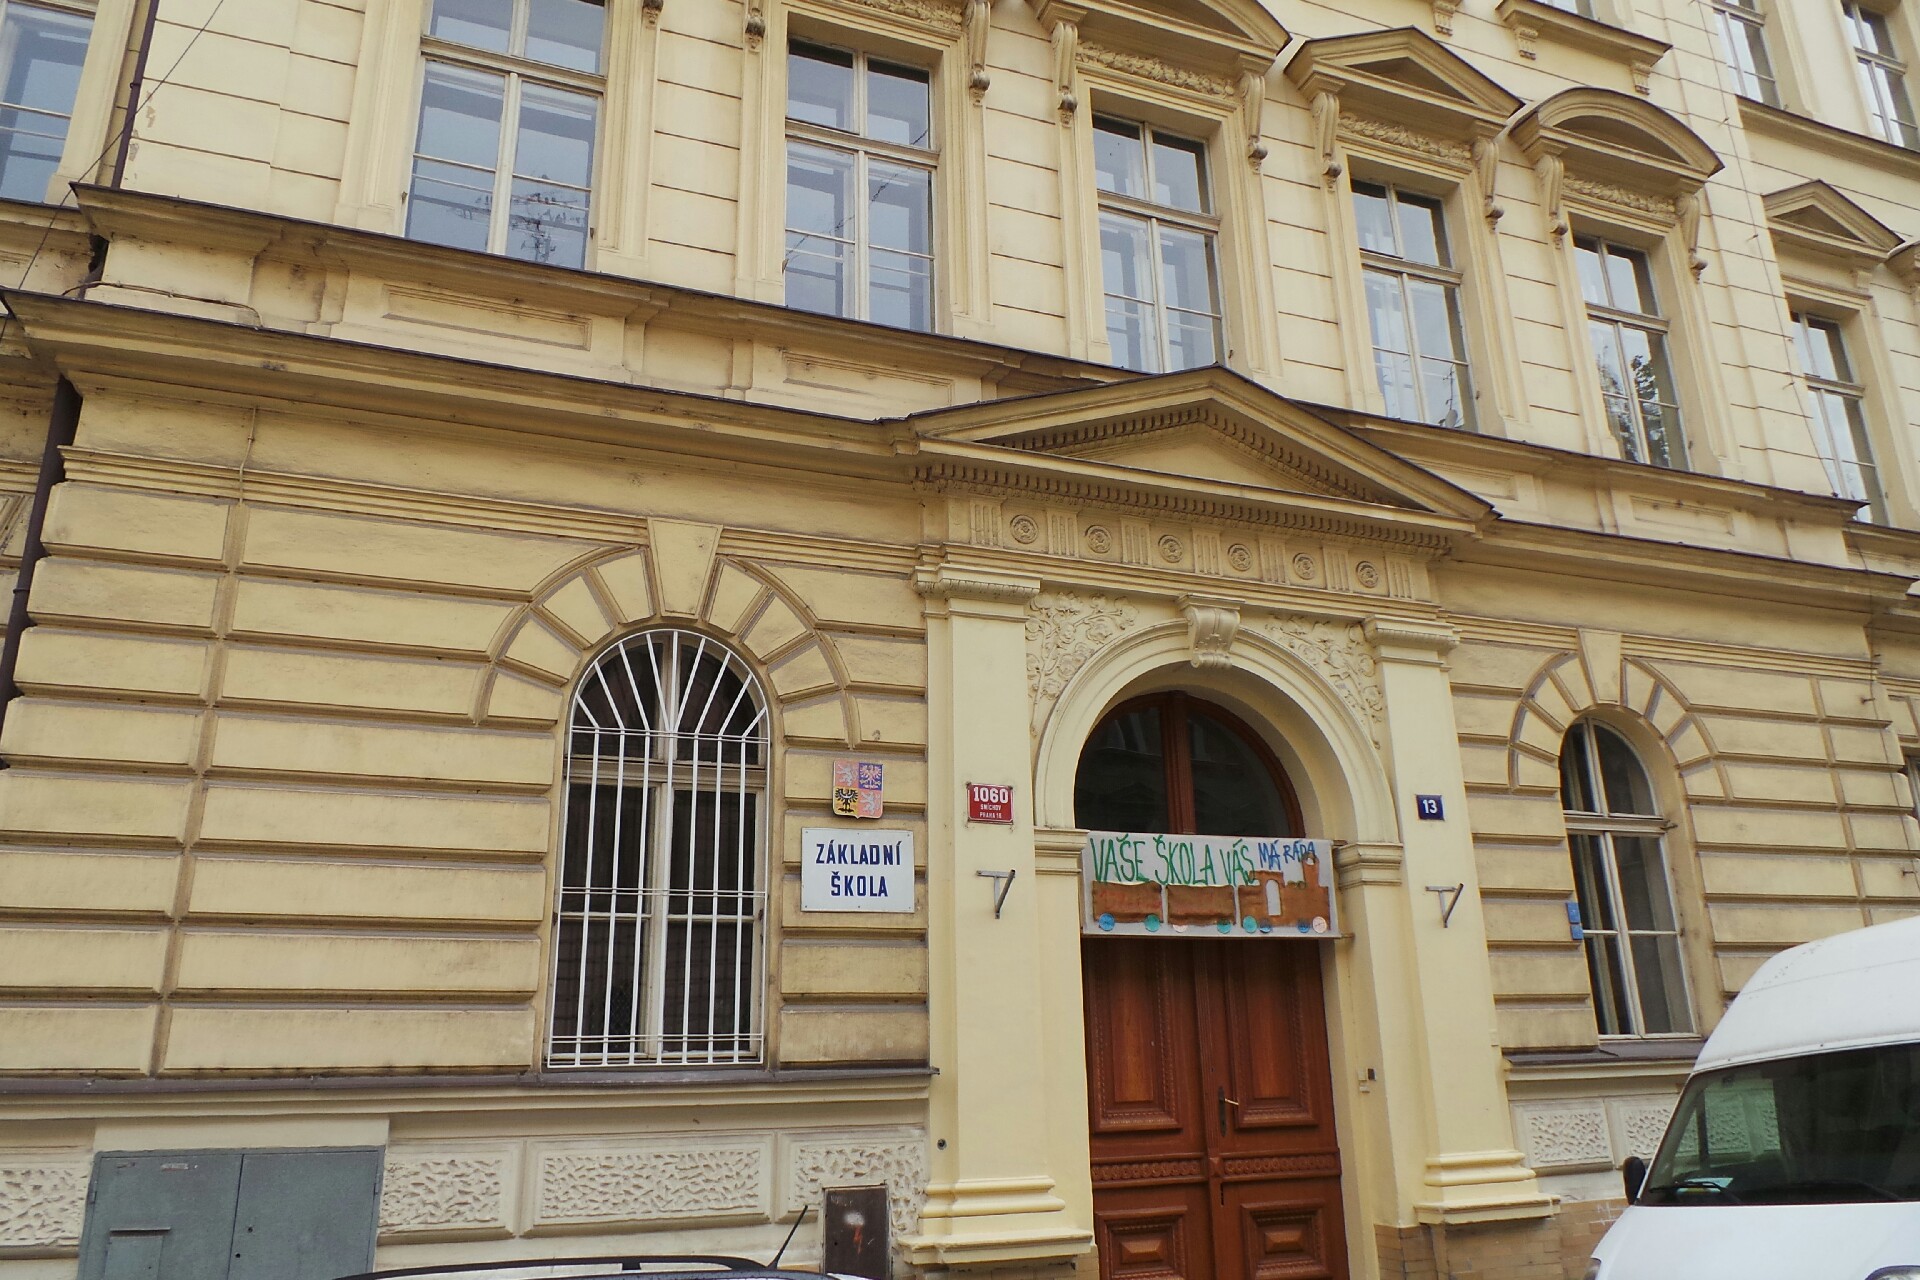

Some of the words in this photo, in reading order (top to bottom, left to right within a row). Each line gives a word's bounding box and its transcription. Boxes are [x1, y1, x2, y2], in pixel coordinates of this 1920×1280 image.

[974, 786, 1009, 804] 1060
[1422, 799, 1438, 814] 13
[816, 839, 902, 866] ZÁKLADNÍ
[1089, 833, 1150, 883] VAŠE
[1153, 835, 1217, 885] ŠKOLA
[1219, 838, 1256, 886] VÁS
[1258, 840, 1281, 871] MÁ
[1283, 840, 1316, 864] RÁDA
[830, 871, 888, 897] ŠKOLA
